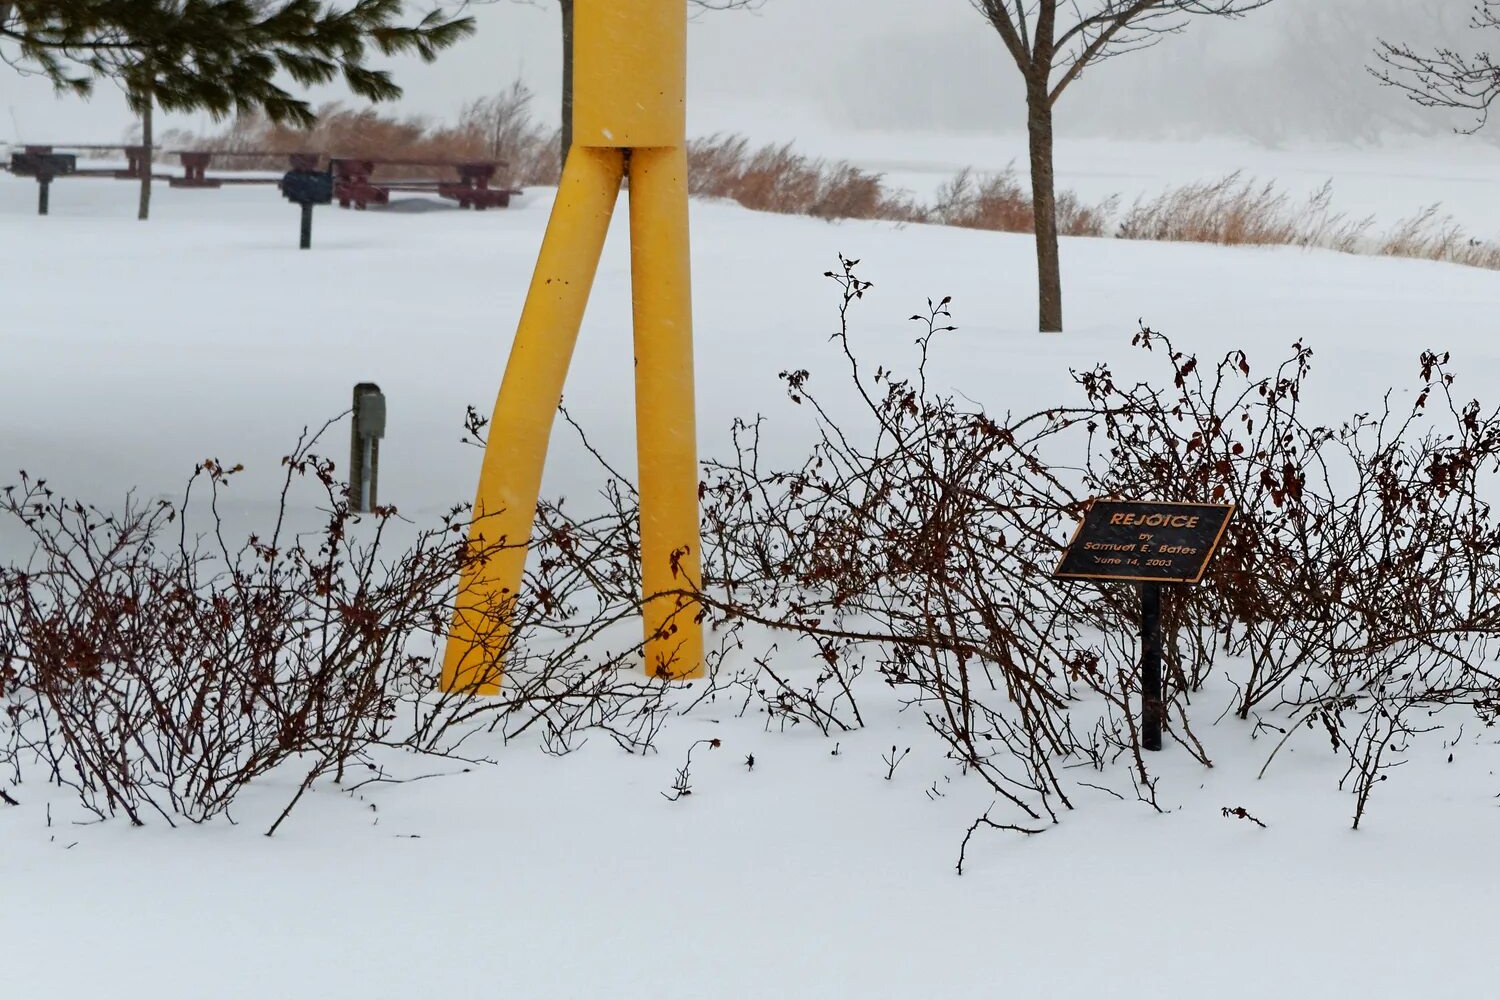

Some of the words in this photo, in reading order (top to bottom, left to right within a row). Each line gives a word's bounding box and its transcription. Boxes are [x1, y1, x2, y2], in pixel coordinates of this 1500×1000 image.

[1110, 512, 1199, 528] REJOICE
[1138, 532, 1154, 541] by
[1084, 541, 1136, 552] Samuel
[1140, 544, 1152, 553] E.
[1159, 545, 1197, 555] Bates
[1094, 556, 1121, 565] June
[1127, 558, 1140, 567] 14,
[1146, 559, 1172, 567] 2003
